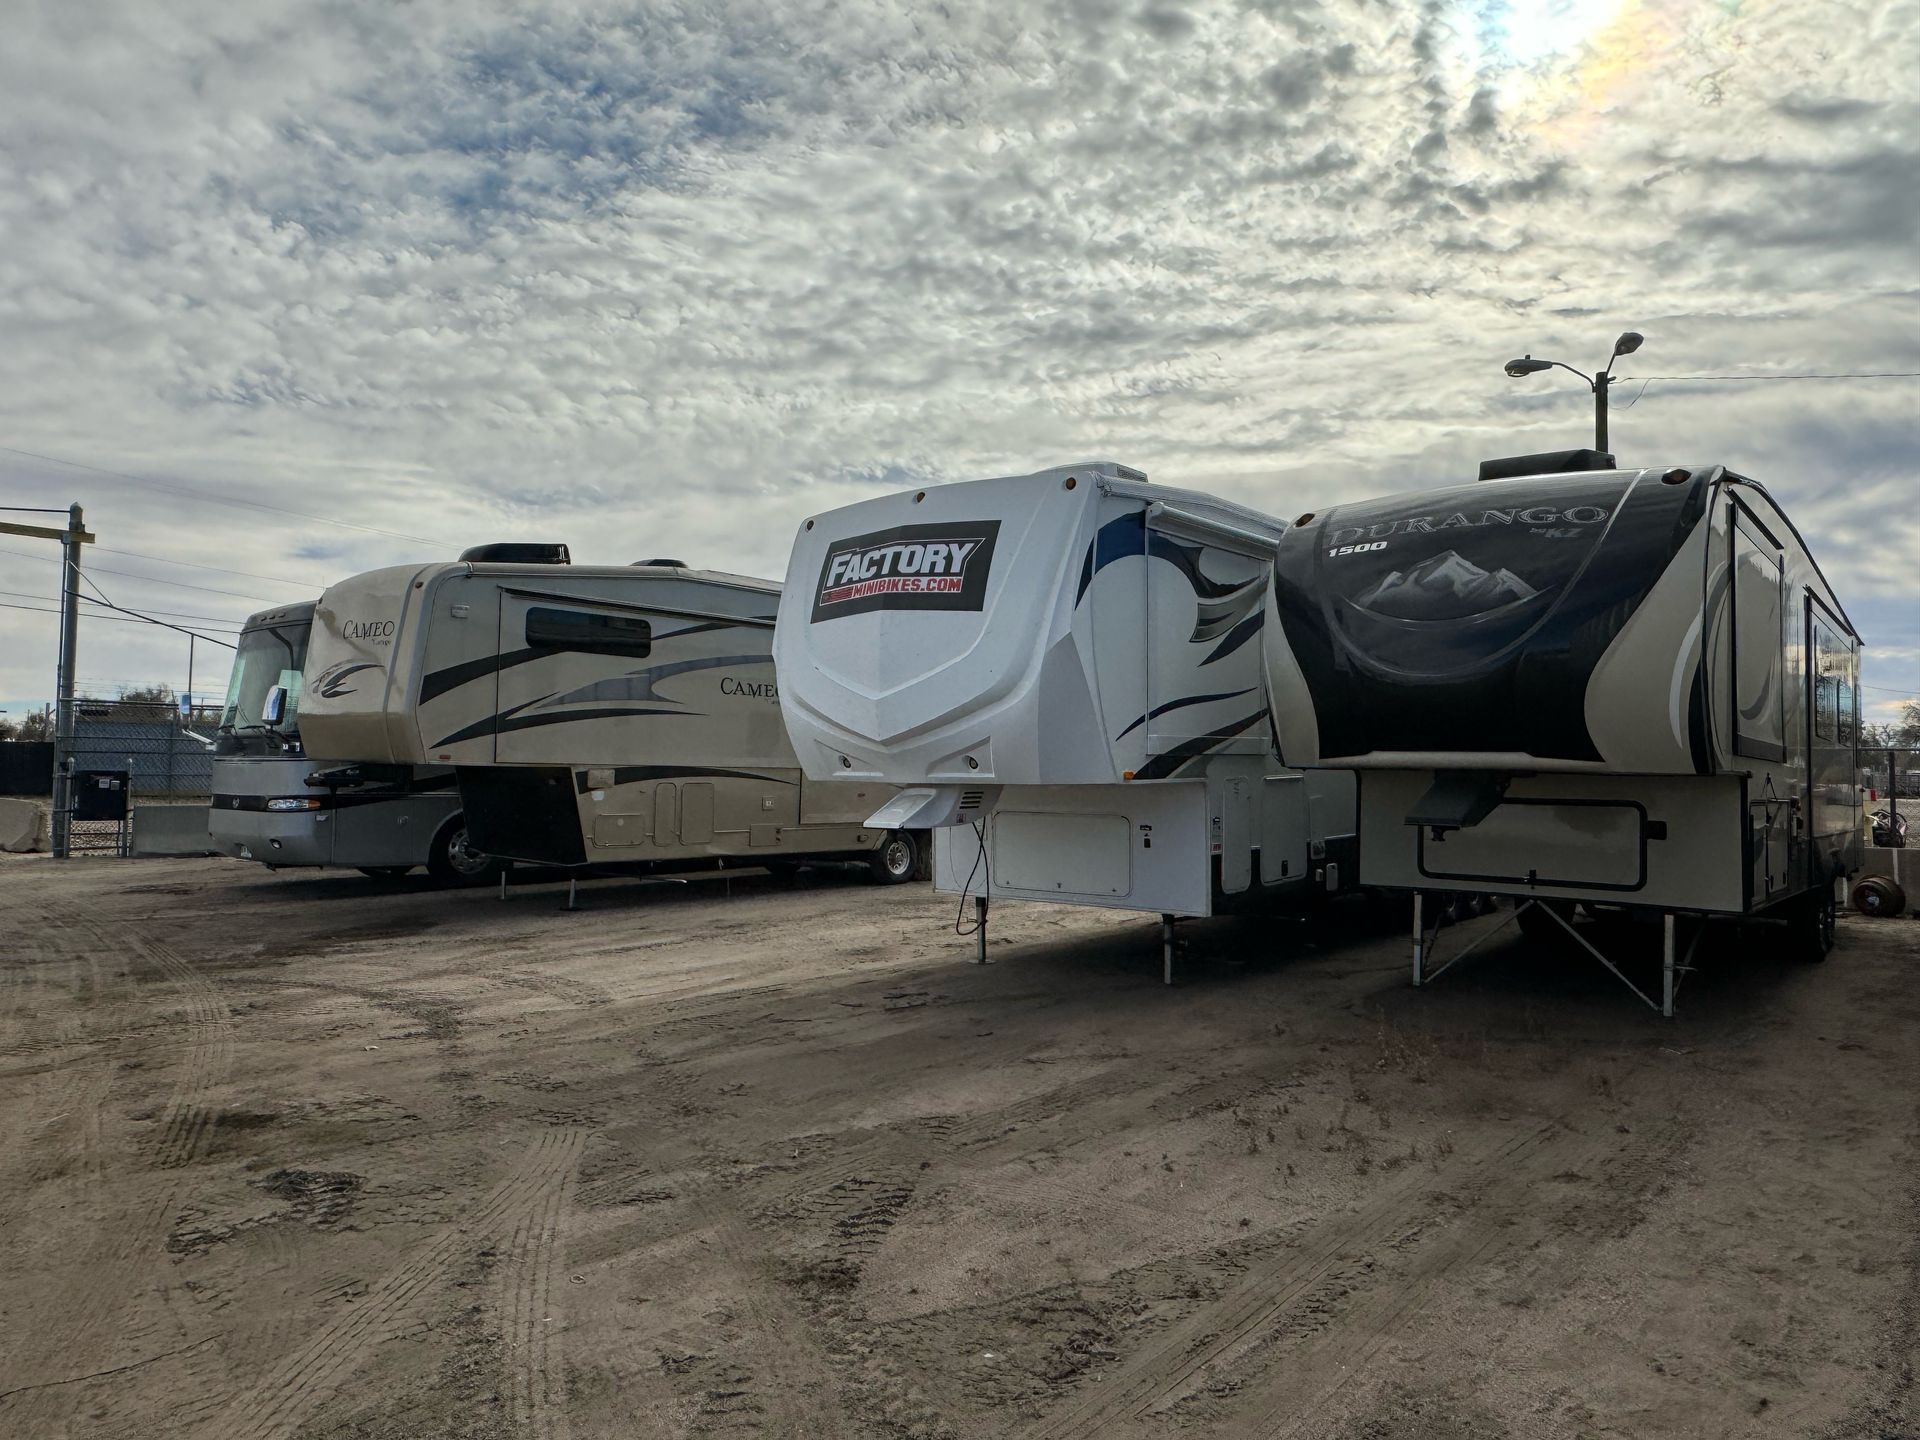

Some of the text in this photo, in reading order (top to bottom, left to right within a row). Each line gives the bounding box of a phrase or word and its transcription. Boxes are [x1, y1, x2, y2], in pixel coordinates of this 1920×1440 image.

[1328, 506, 1609, 546] DURANGO
[1328, 541, 1388, 557] 1500
[826, 543, 975, 587] FACTORY
[852, 578, 962, 597] MINIBIKES.COM
[343, 620, 395, 640] CAMEO
[720, 677, 779, 698] CAME
